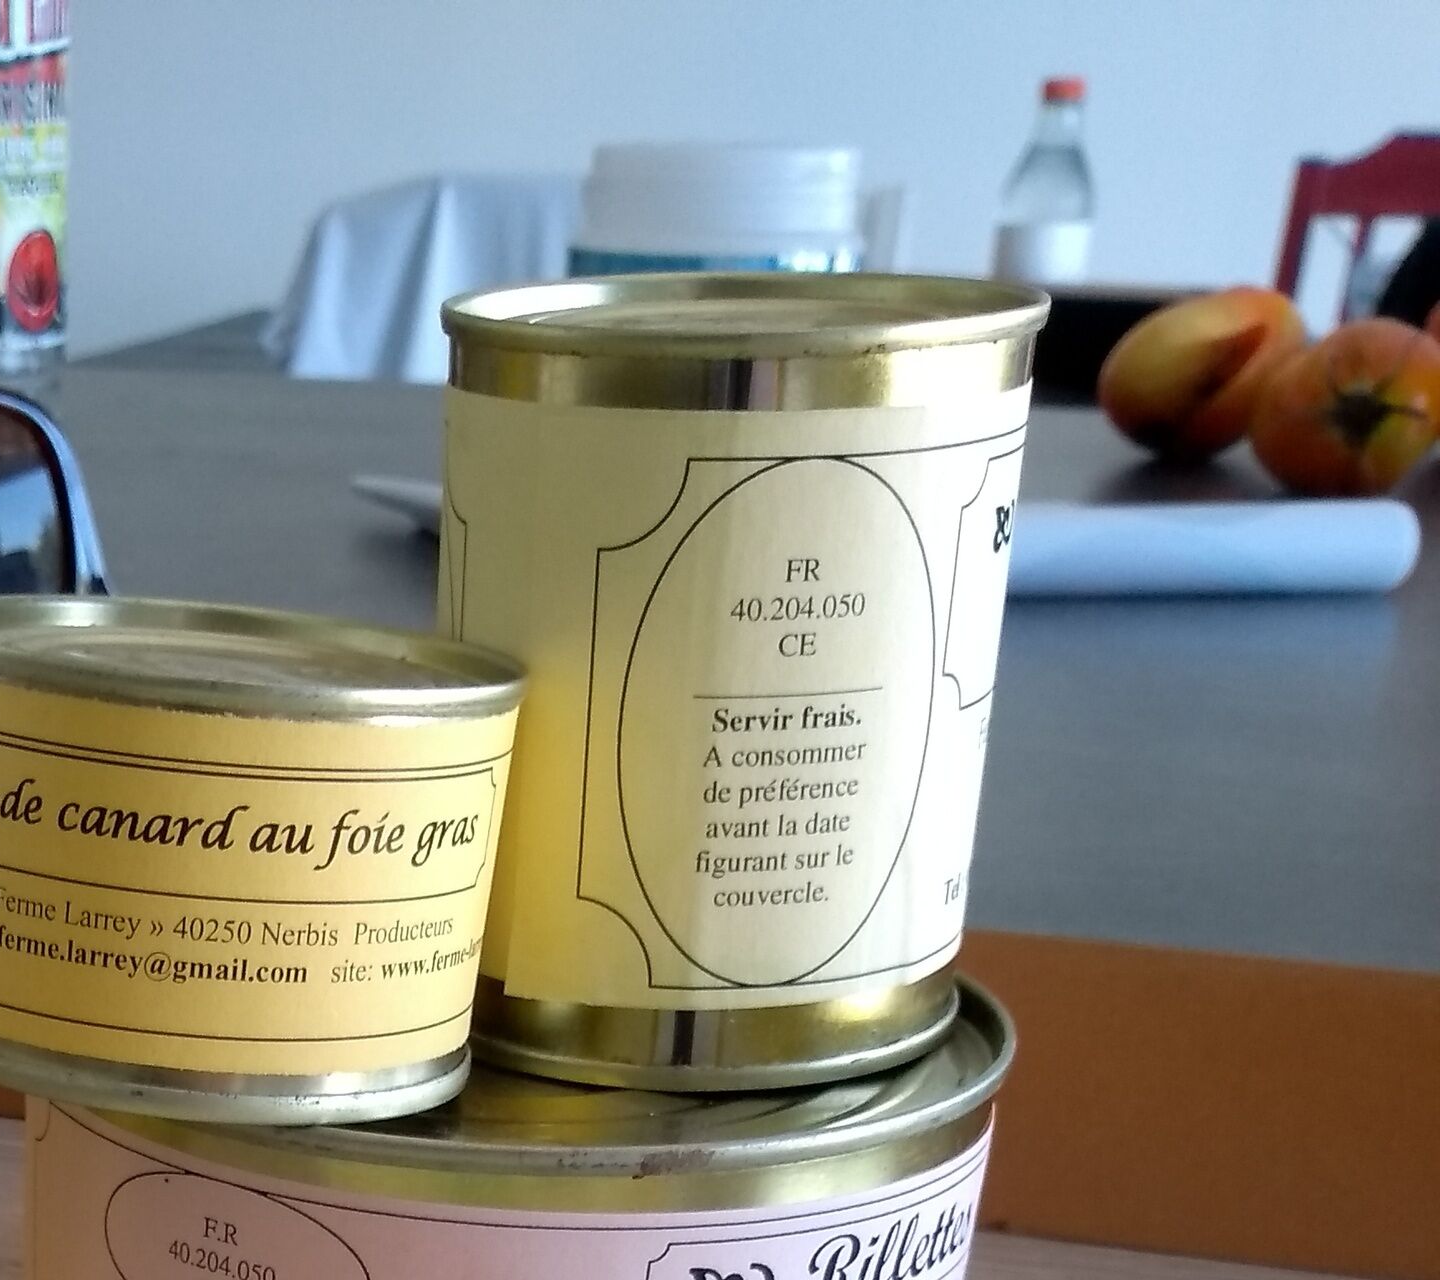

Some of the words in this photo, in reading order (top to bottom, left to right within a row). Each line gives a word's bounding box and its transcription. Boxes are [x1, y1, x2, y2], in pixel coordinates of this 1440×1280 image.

[785, 557, 821, 583] FR
[730, 592, 866, 622] 40.204.050
[778, 632, 817, 658] CE
[711, 707, 794, 733] Servir
[801, 703, 862, 730] frais.
[703, 746, 722, 769] A
[731, 740, 867, 769] consommer
[703, 780, 732, 805] de
[738, 777, 859, 809] préférence
[0, 778, 43, 825] de
[57, 801, 250, 851] canard
[249, 821, 315, 855] au
[313, 809, 405, 871] foie
[410, 814, 479, 867] gras
[705, 816, 770, 839] avant
[777, 813, 798, 838] la
[805, 811, 851, 836] date
[694, 849, 788, 879] figurant
[794, 849, 831, 869] sur
[835, 843, 854, 867] le
[713, 880, 830, 908] couvercle.
[63, 900, 141, 940] Larrey
[172, 915, 252, 945] 40250
[261, 921, 339, 947] Nerbis
[353, 916, 454, 946] Producteurs
[331, 958, 374, 985] site:
[202, 1216, 238, 1247] F.R
